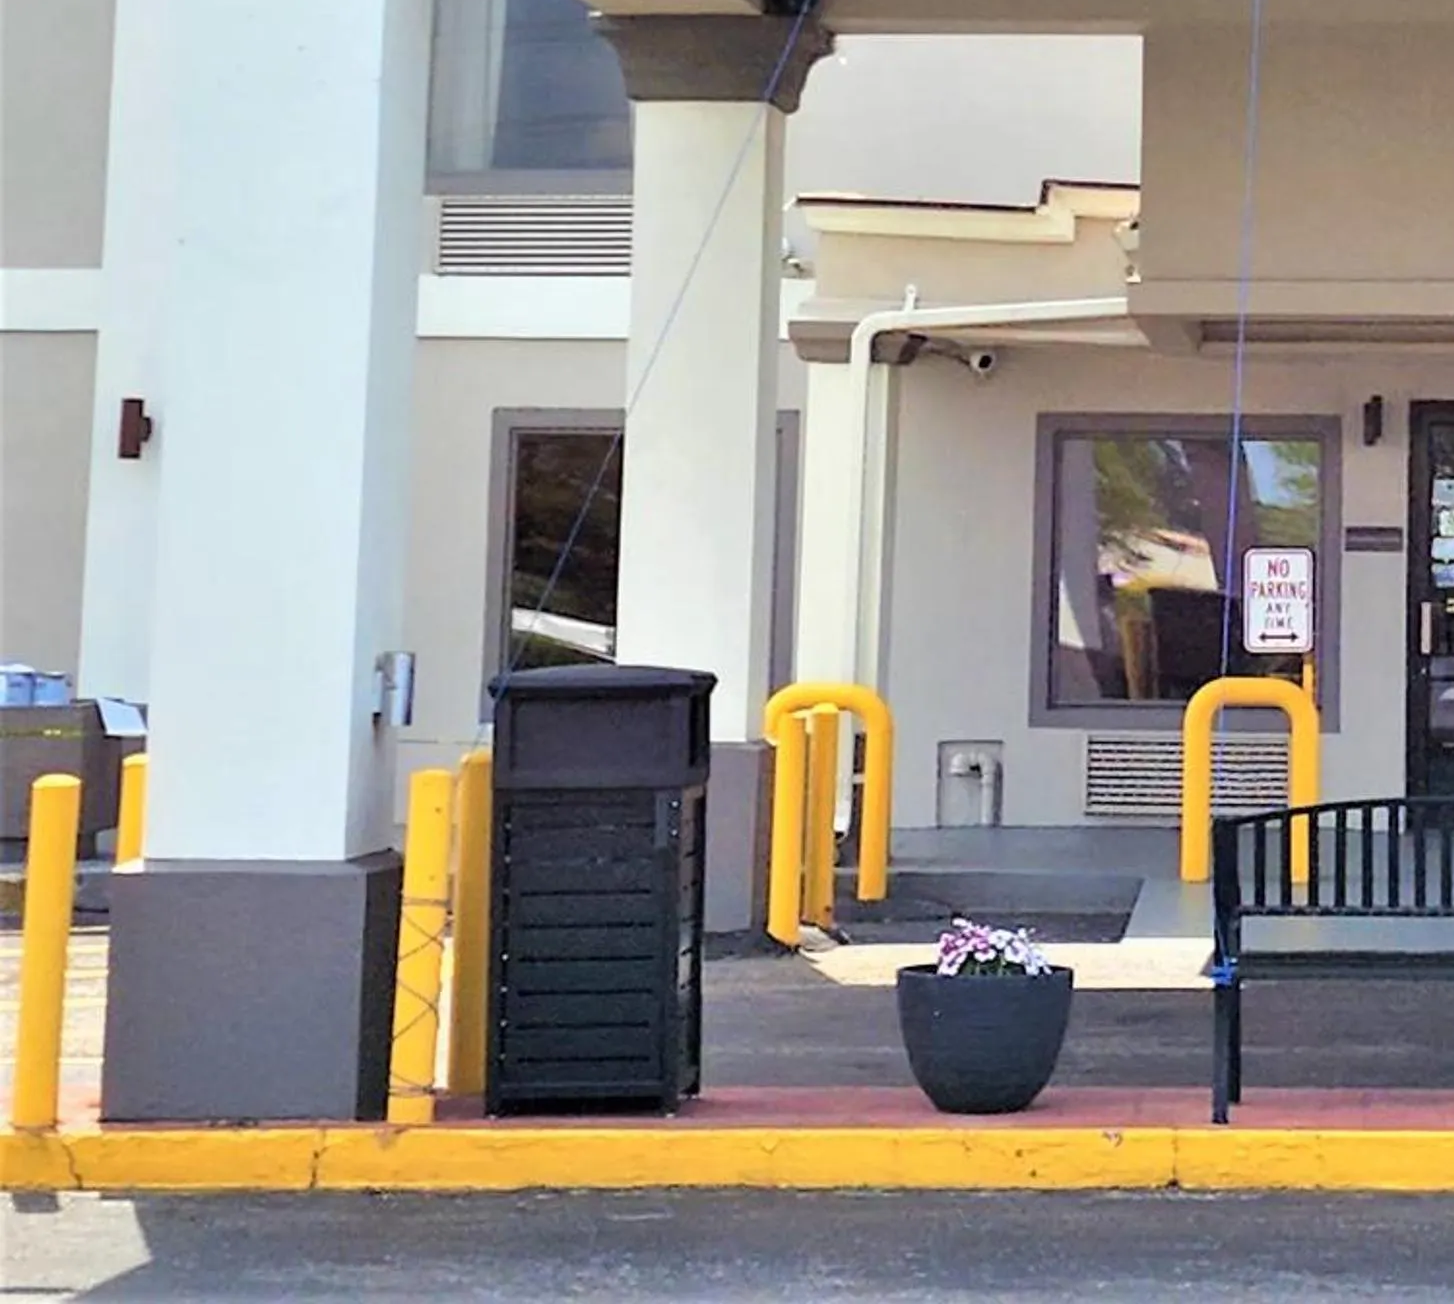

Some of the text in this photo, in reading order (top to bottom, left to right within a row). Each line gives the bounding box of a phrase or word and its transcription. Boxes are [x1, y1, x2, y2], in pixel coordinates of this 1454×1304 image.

[1267, 559, 1290, 578] NO
[1249, 581, 1306, 600] PARKING
[1266, 602, 1291, 614] ANY
